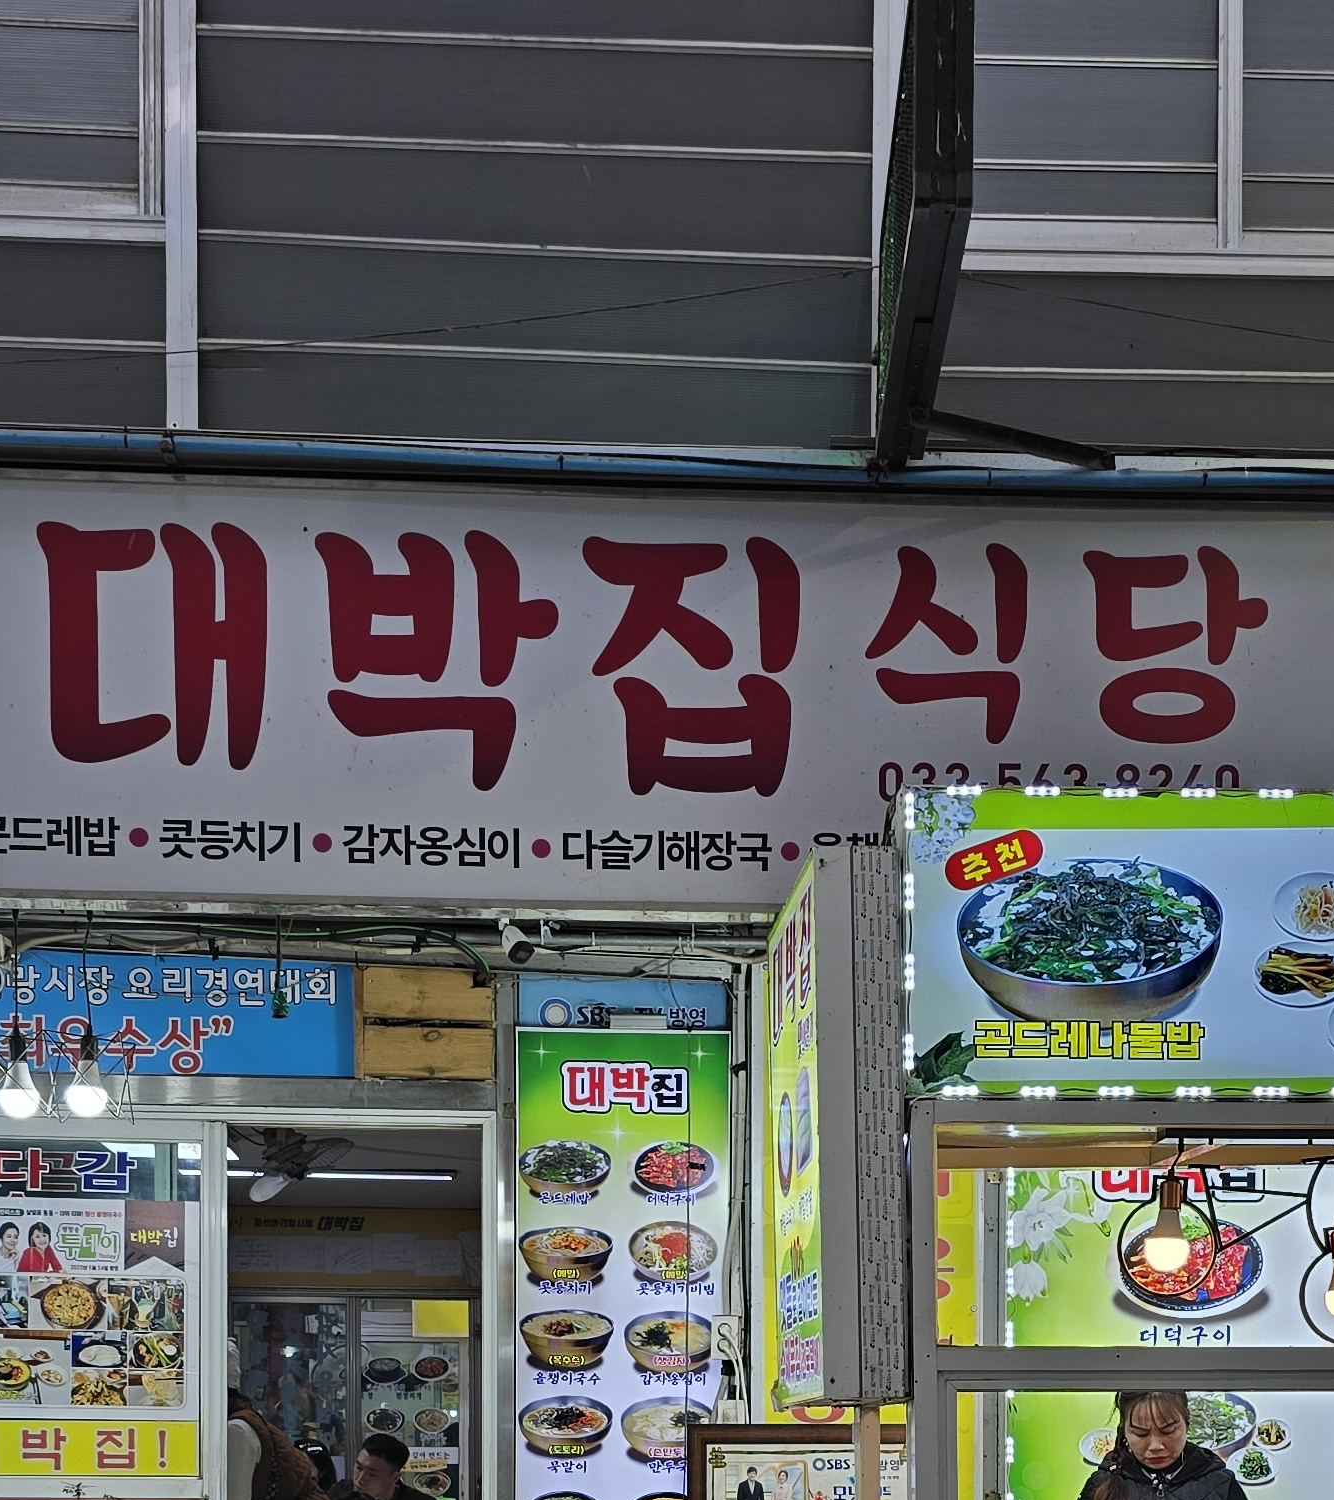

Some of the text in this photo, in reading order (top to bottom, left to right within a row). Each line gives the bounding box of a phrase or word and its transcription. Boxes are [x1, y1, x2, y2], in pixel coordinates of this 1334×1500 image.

[36, 520, 1269, 797] 대박집 식당
[158, 817, 302, 862] 콧등치기
[342, 825, 521, 870] 감자옹심이
[561, 827, 772, 871] 다슬기해장국
[961, 837, 1028, 884] 추천
[127, 965, 338, 1007] 요리경연대회
[669, 1006, 706, 1029] 방영
[972, 1020, 1207, 1063] 곤드레나물밥
[566, 1065, 684, 1109] 대박집
[538, 1191, 592, 1206] 곤드레밥
[646, 1192, 697, 1207] 더덕구이
[316, 1216, 365, 1232] 대박집
[56, 1231, 118, 1258] 투데이
[129, 1226, 179, 1248] 대박집
[1138, 1324, 1232, 1347] 더덕구이
[826, 1458, 851, 1470] SBS
